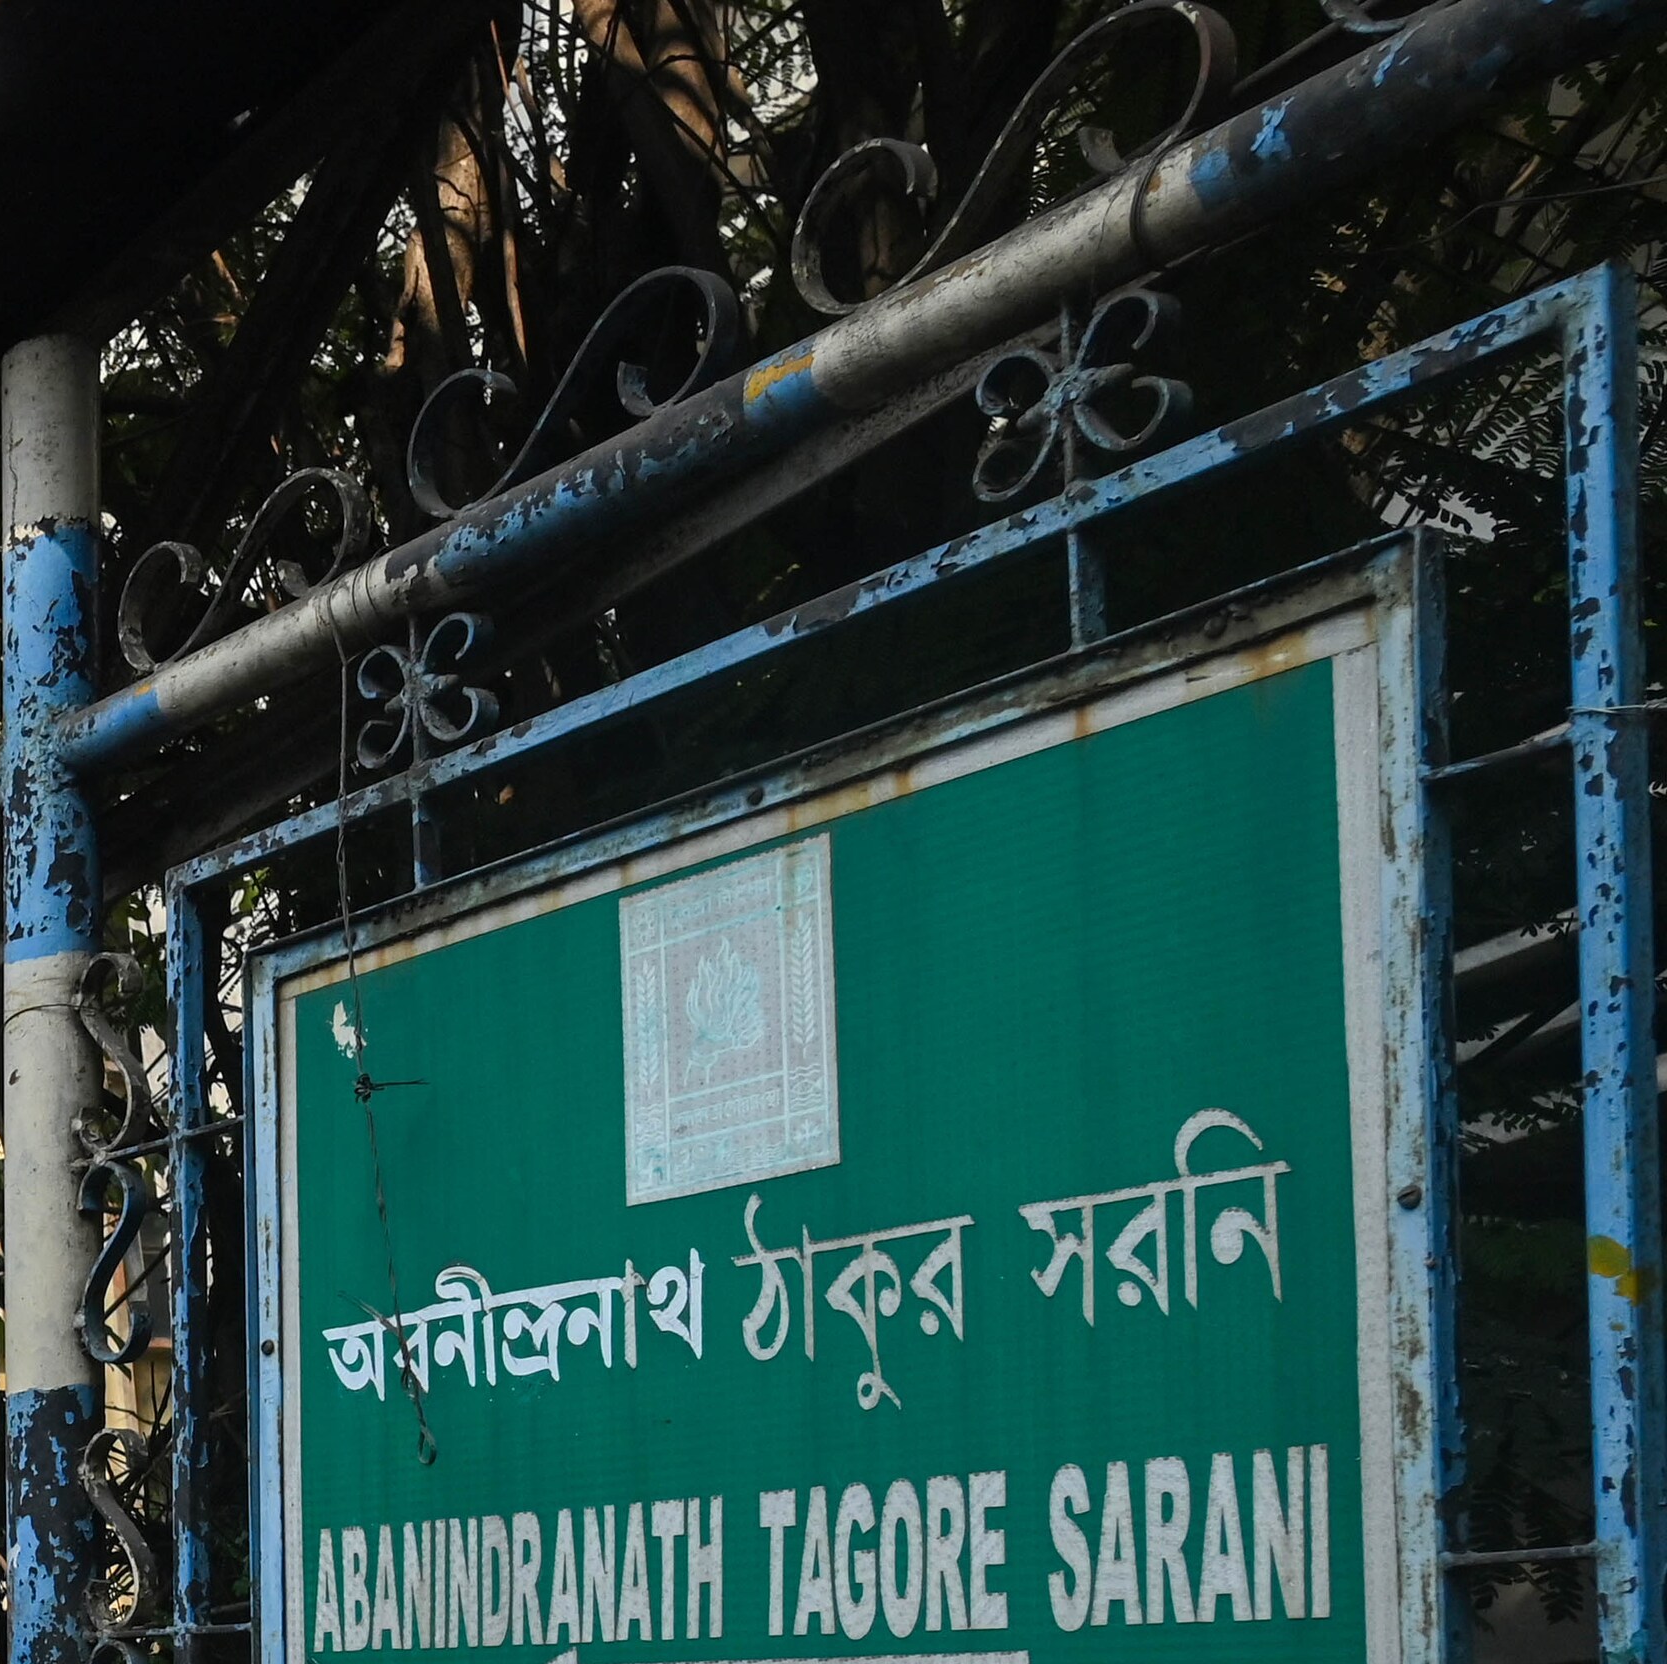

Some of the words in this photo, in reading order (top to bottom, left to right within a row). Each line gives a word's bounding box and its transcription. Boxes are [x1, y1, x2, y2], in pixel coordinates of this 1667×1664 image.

[731, 1193, 975, 1410] ঠাকুর
[1019, 1107, 1292, 1327] সরনি
[313, 1496, 723, 1653] ABANINDRANATH
[759, 1471, 1009, 1639] TAGORE
[1048, 1444, 1331, 1632] SARANI
